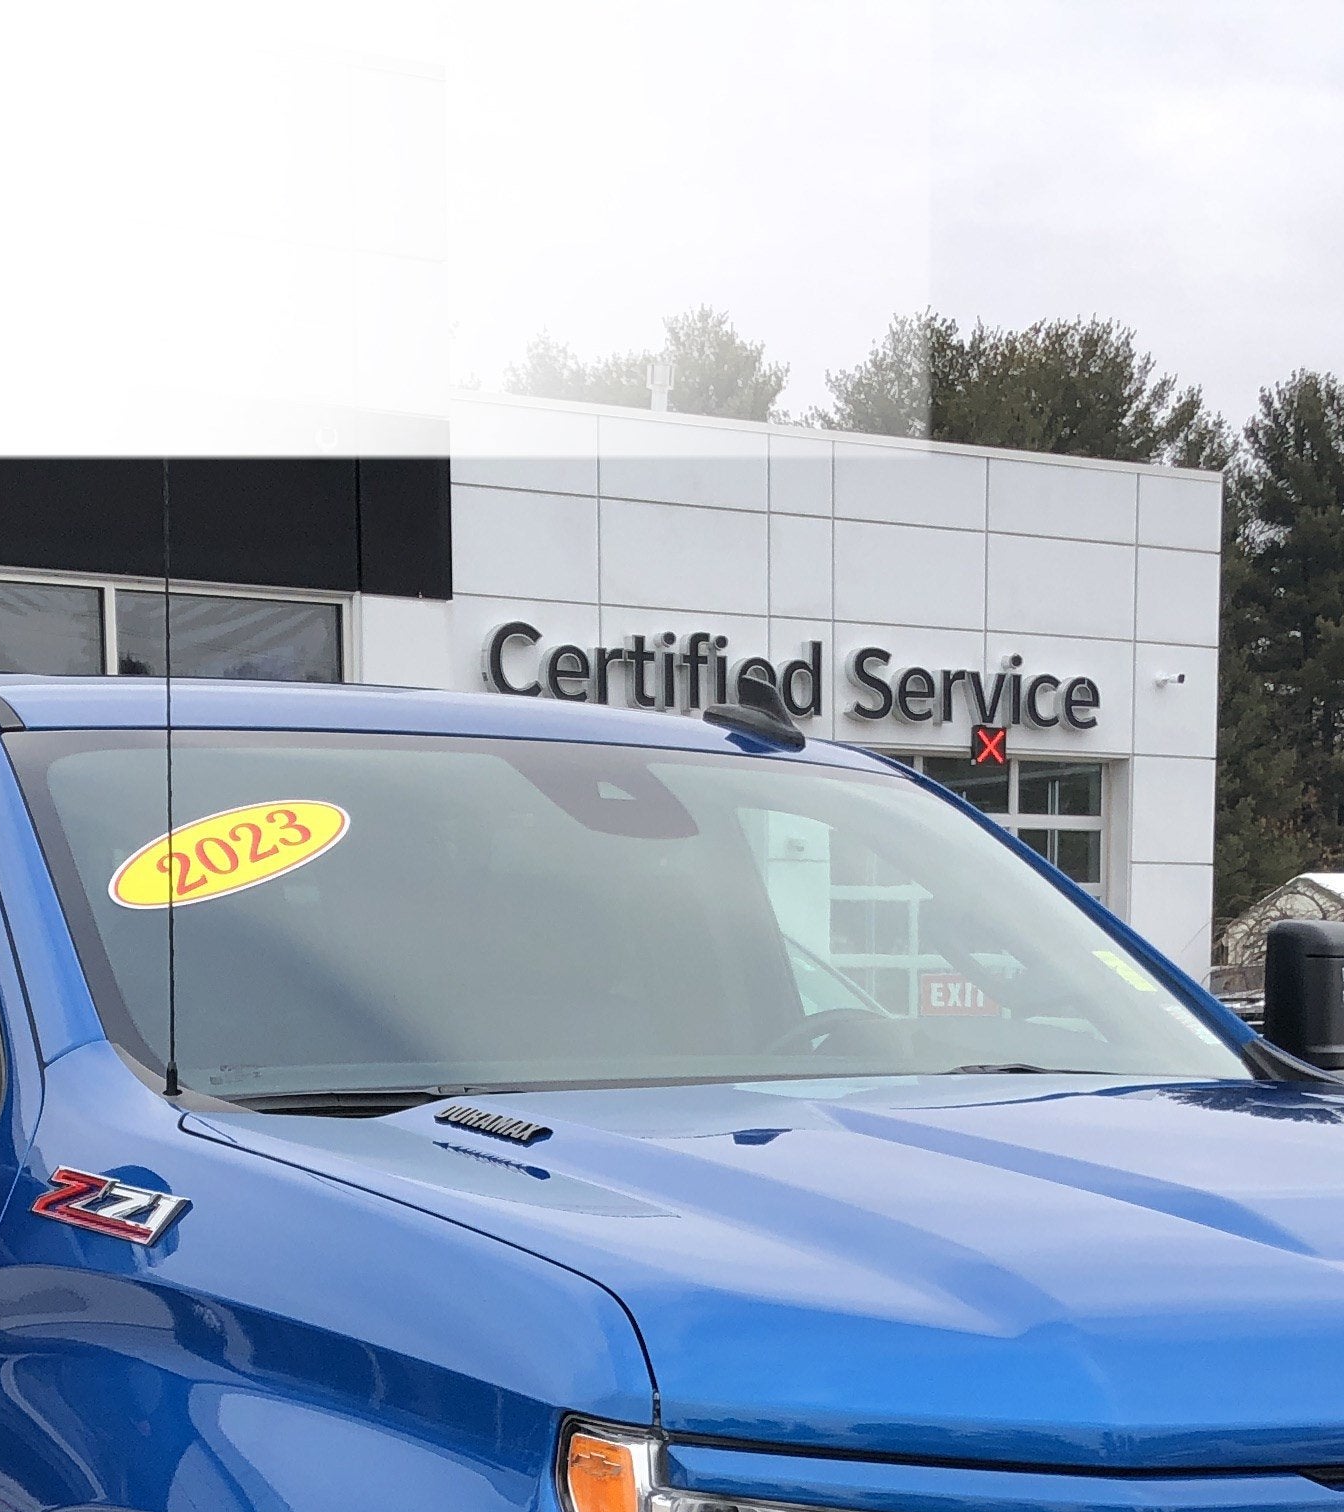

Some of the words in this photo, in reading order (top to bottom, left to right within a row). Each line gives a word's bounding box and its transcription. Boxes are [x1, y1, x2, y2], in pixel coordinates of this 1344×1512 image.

[484, 620, 824, 718] Certified
[847, 645, 1101, 731] Service
[156, 808, 313, 896] 2023
[30, 1164, 194, 1247] Z71
